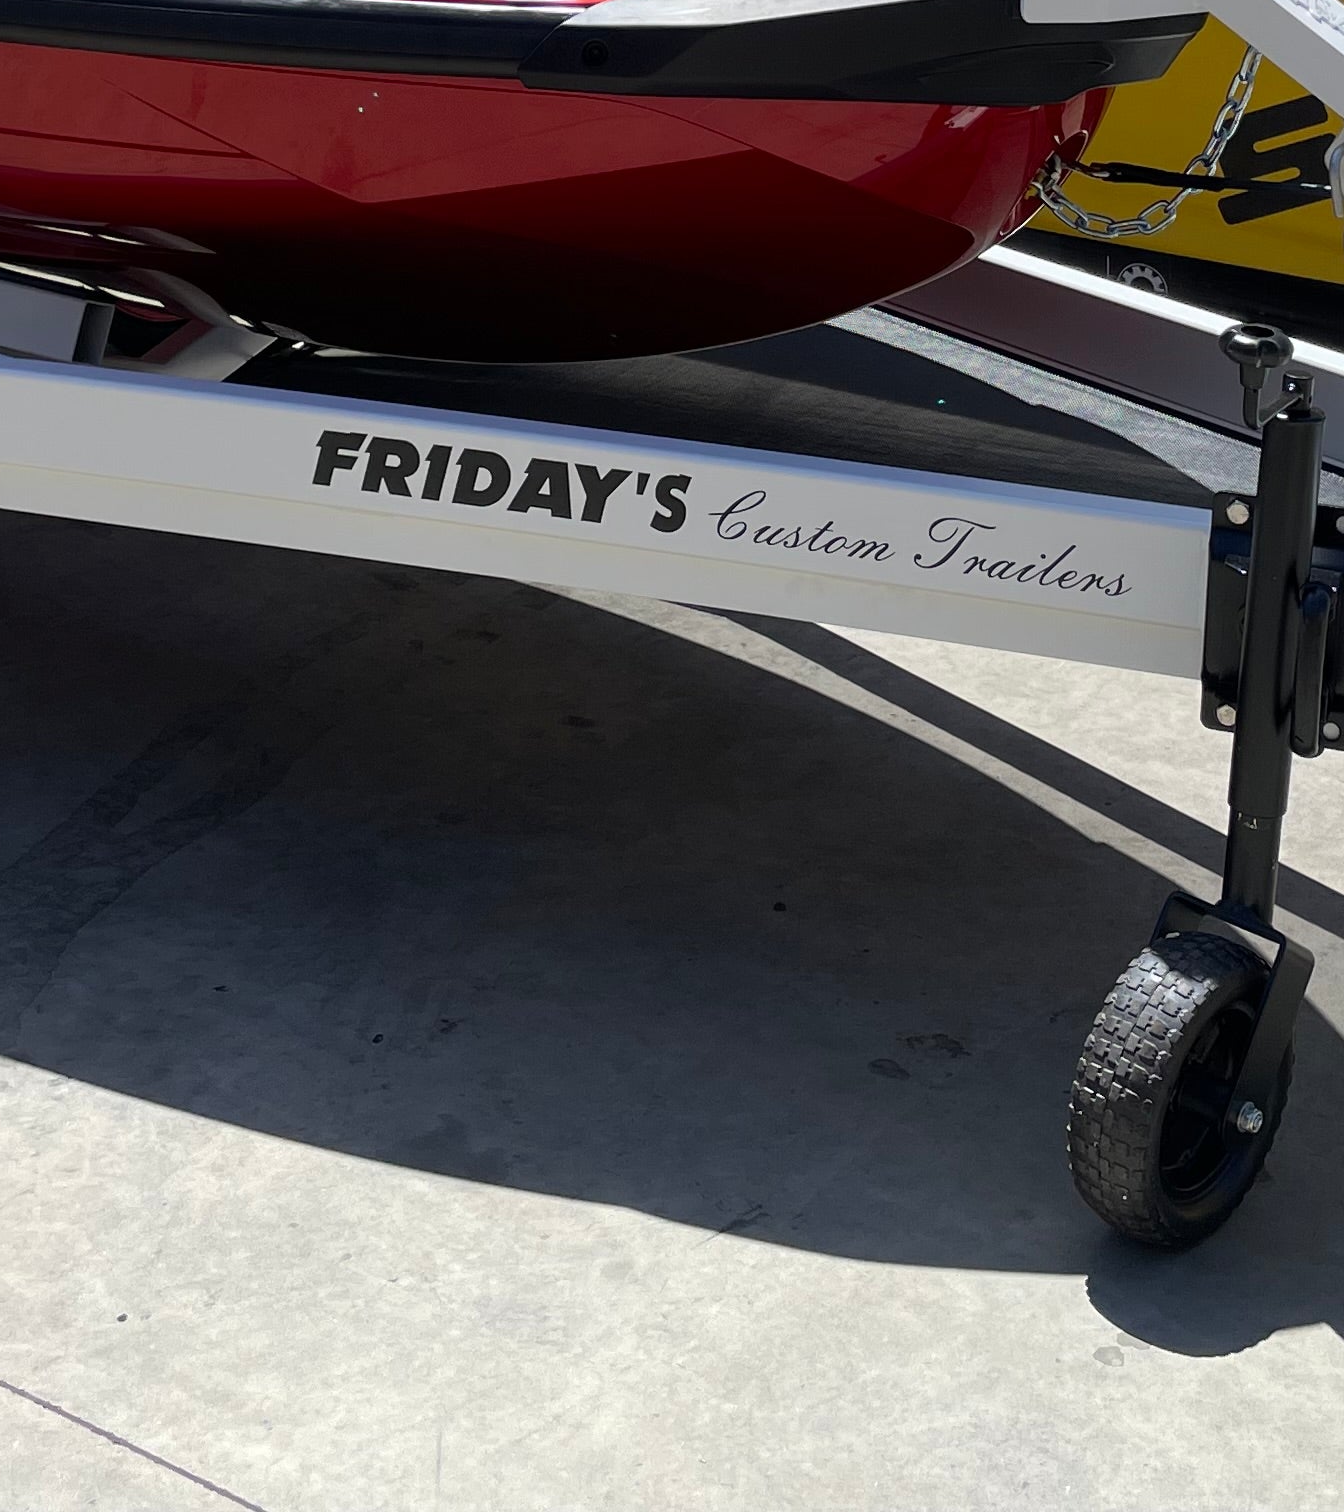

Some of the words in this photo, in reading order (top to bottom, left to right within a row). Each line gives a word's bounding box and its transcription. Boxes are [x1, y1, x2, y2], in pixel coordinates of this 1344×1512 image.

[312, 429, 693, 534] FRIDAY'S
[708, 489, 896, 564] Custom
[913, 515, 1134, 599] Trailers
